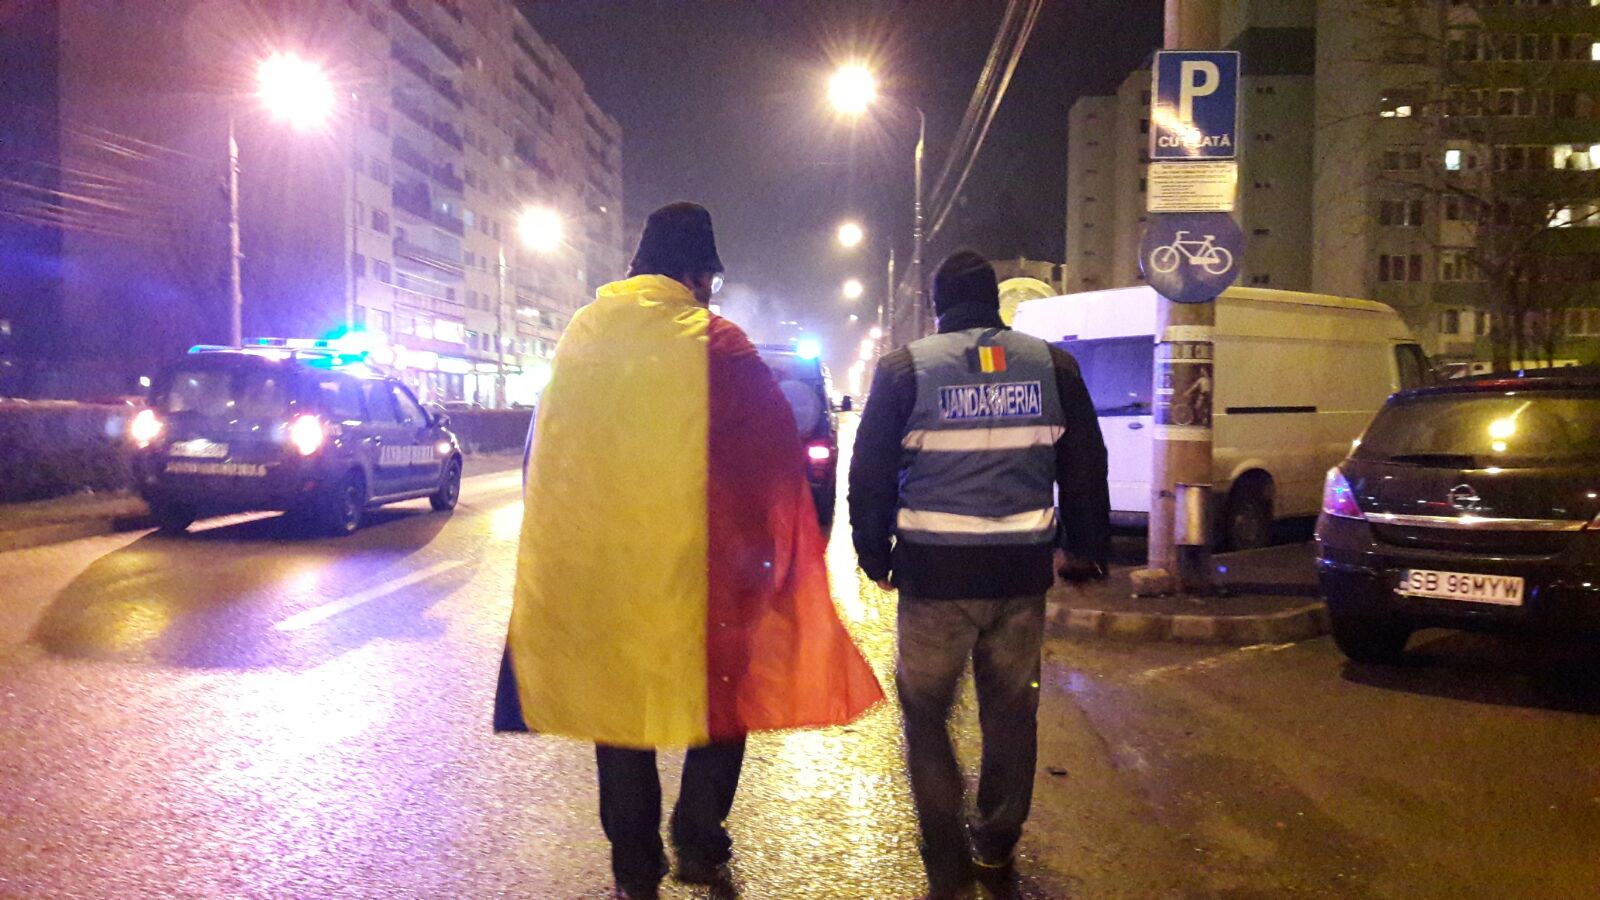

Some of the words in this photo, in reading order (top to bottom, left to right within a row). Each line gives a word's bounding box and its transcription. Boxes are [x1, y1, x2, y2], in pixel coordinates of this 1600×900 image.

[1180, 60, 1220, 123] P
[1158, 136, 1180, 148] CU
[1410, 571, 1440, 591] SB
